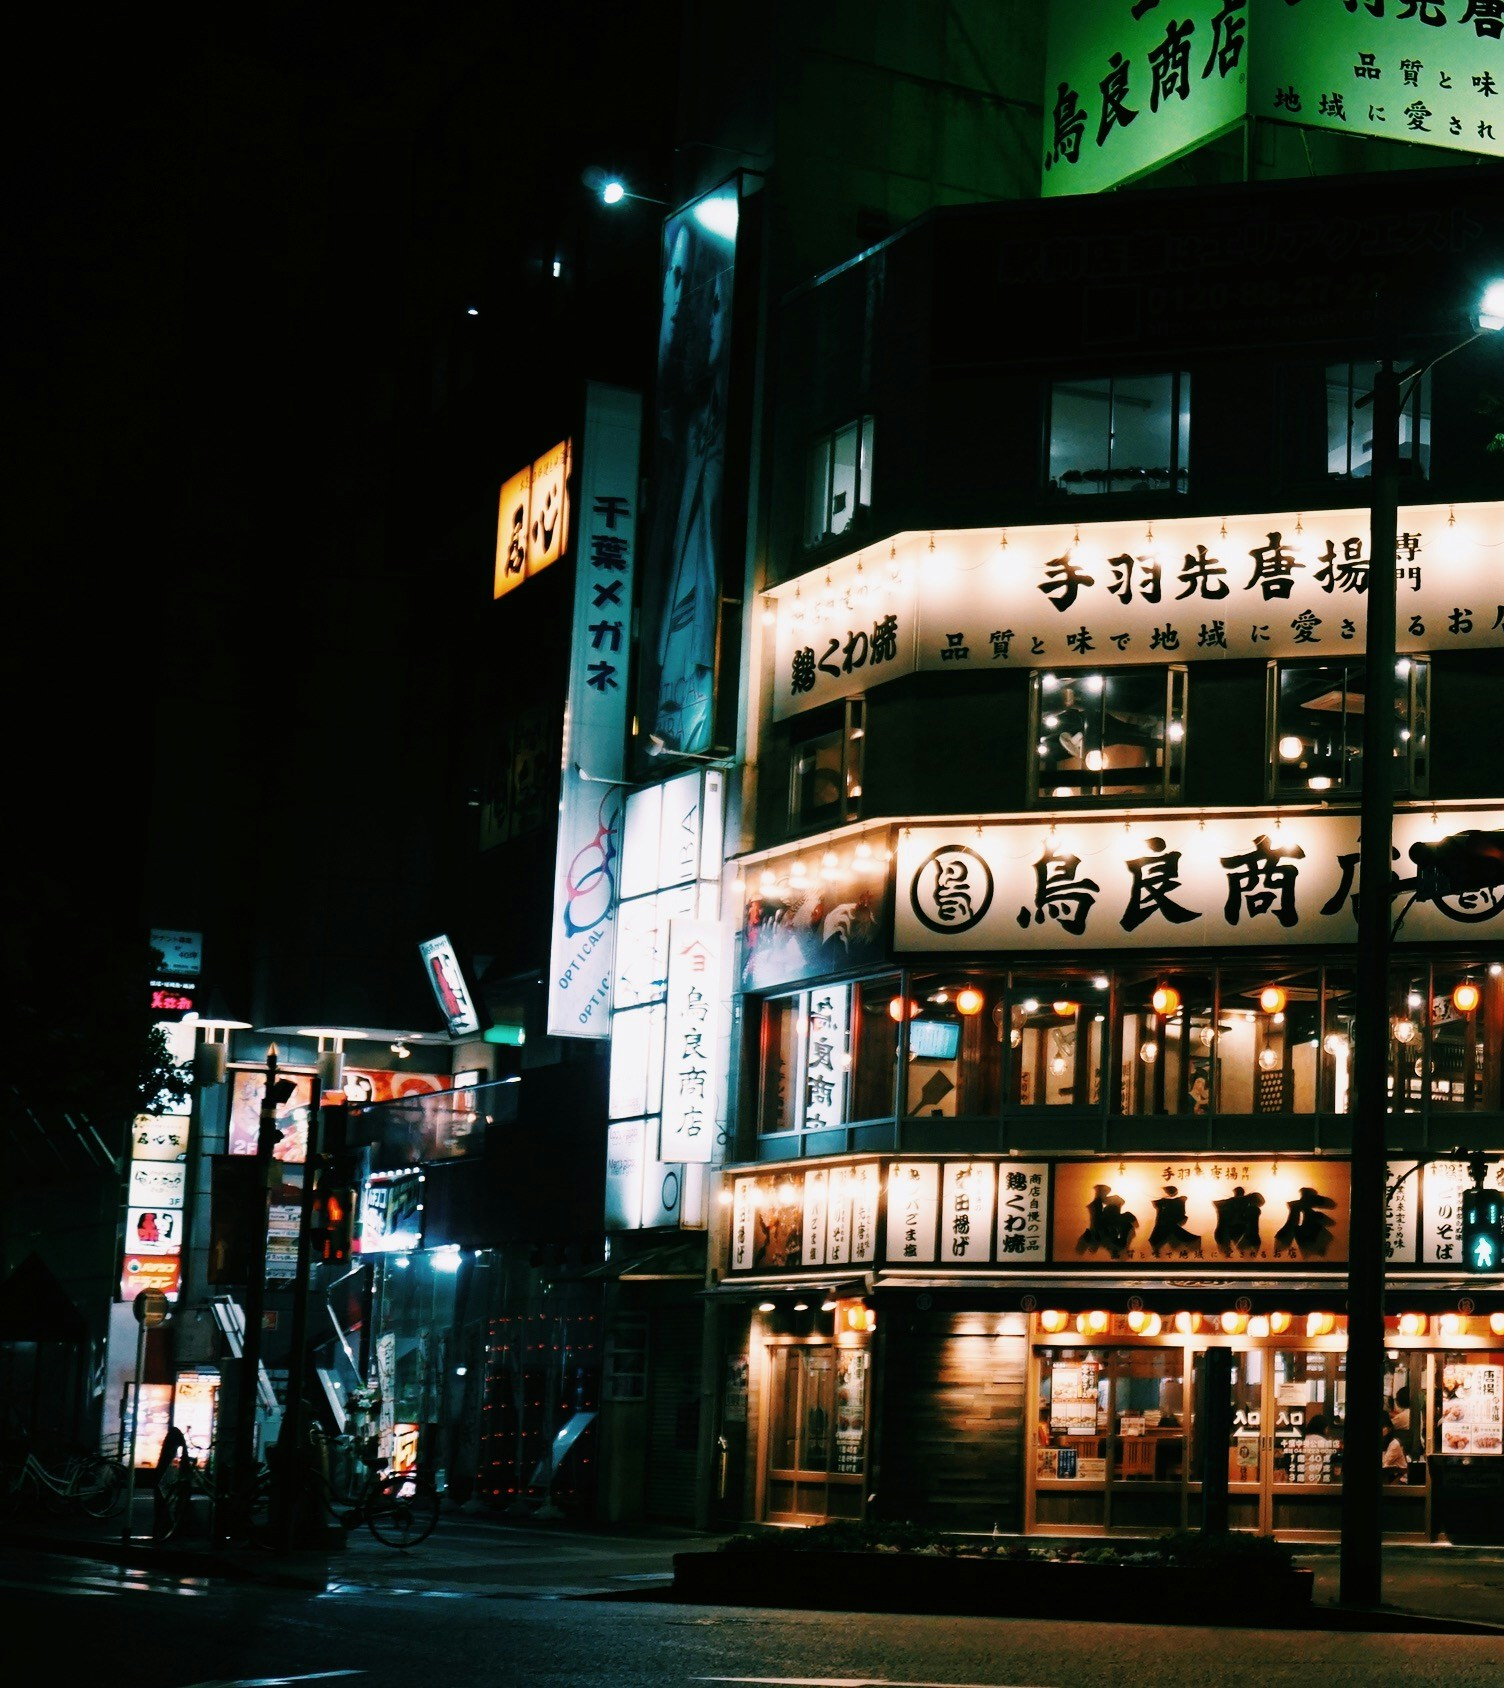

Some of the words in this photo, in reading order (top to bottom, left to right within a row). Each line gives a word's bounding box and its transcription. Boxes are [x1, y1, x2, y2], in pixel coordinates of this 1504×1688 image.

[587, 496, 630, 692] 千葉メガネ
[558, 930, 605, 990] OPTICAL
[1233, 1409, 1260, 1426] 入口
[1276, 1410, 1304, 1426] 入口
